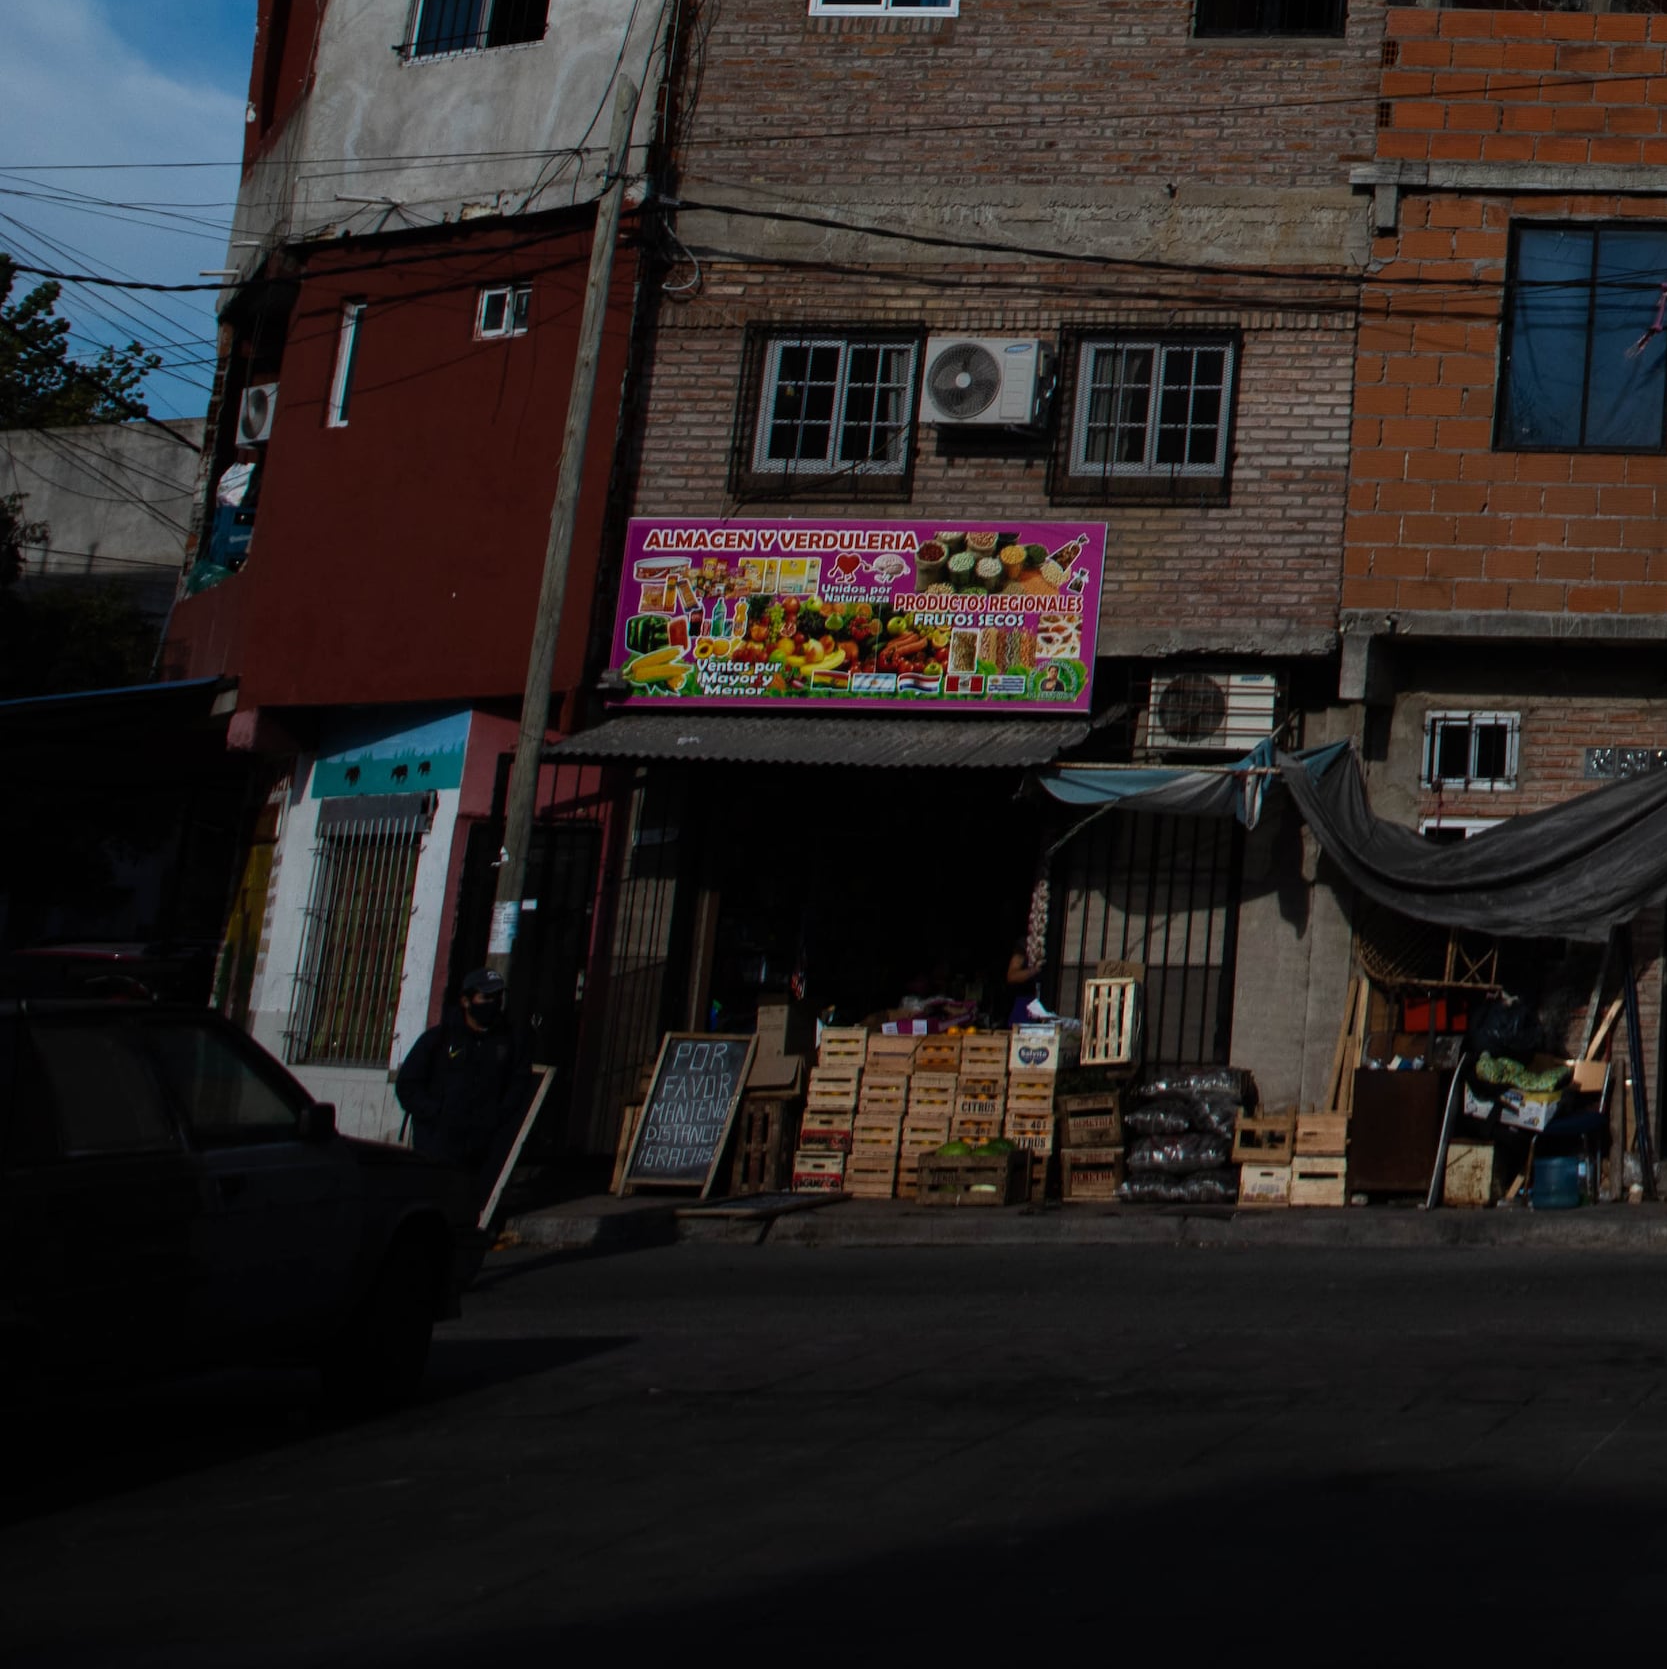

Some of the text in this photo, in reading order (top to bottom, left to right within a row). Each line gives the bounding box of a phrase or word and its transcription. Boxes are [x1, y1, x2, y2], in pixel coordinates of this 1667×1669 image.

[643, 530, 919, 552] ALMACEN Y VERDULERIA
[821, 583, 892, 596] Unidos por
[824, 592, 890, 604] Naturaleza
[893, 594, 1084, 613] PRODUCTOS REGIONALES
[913, 613, 1025, 627] FRUTOS SECOS
[696, 658, 751, 673] Ventas
[701, 671, 774, 687] Mayor y
[703, 684, 765, 696] Menor
[672, 1042, 728, 1071] POR
[662, 1072, 732, 1100] FAVOR
